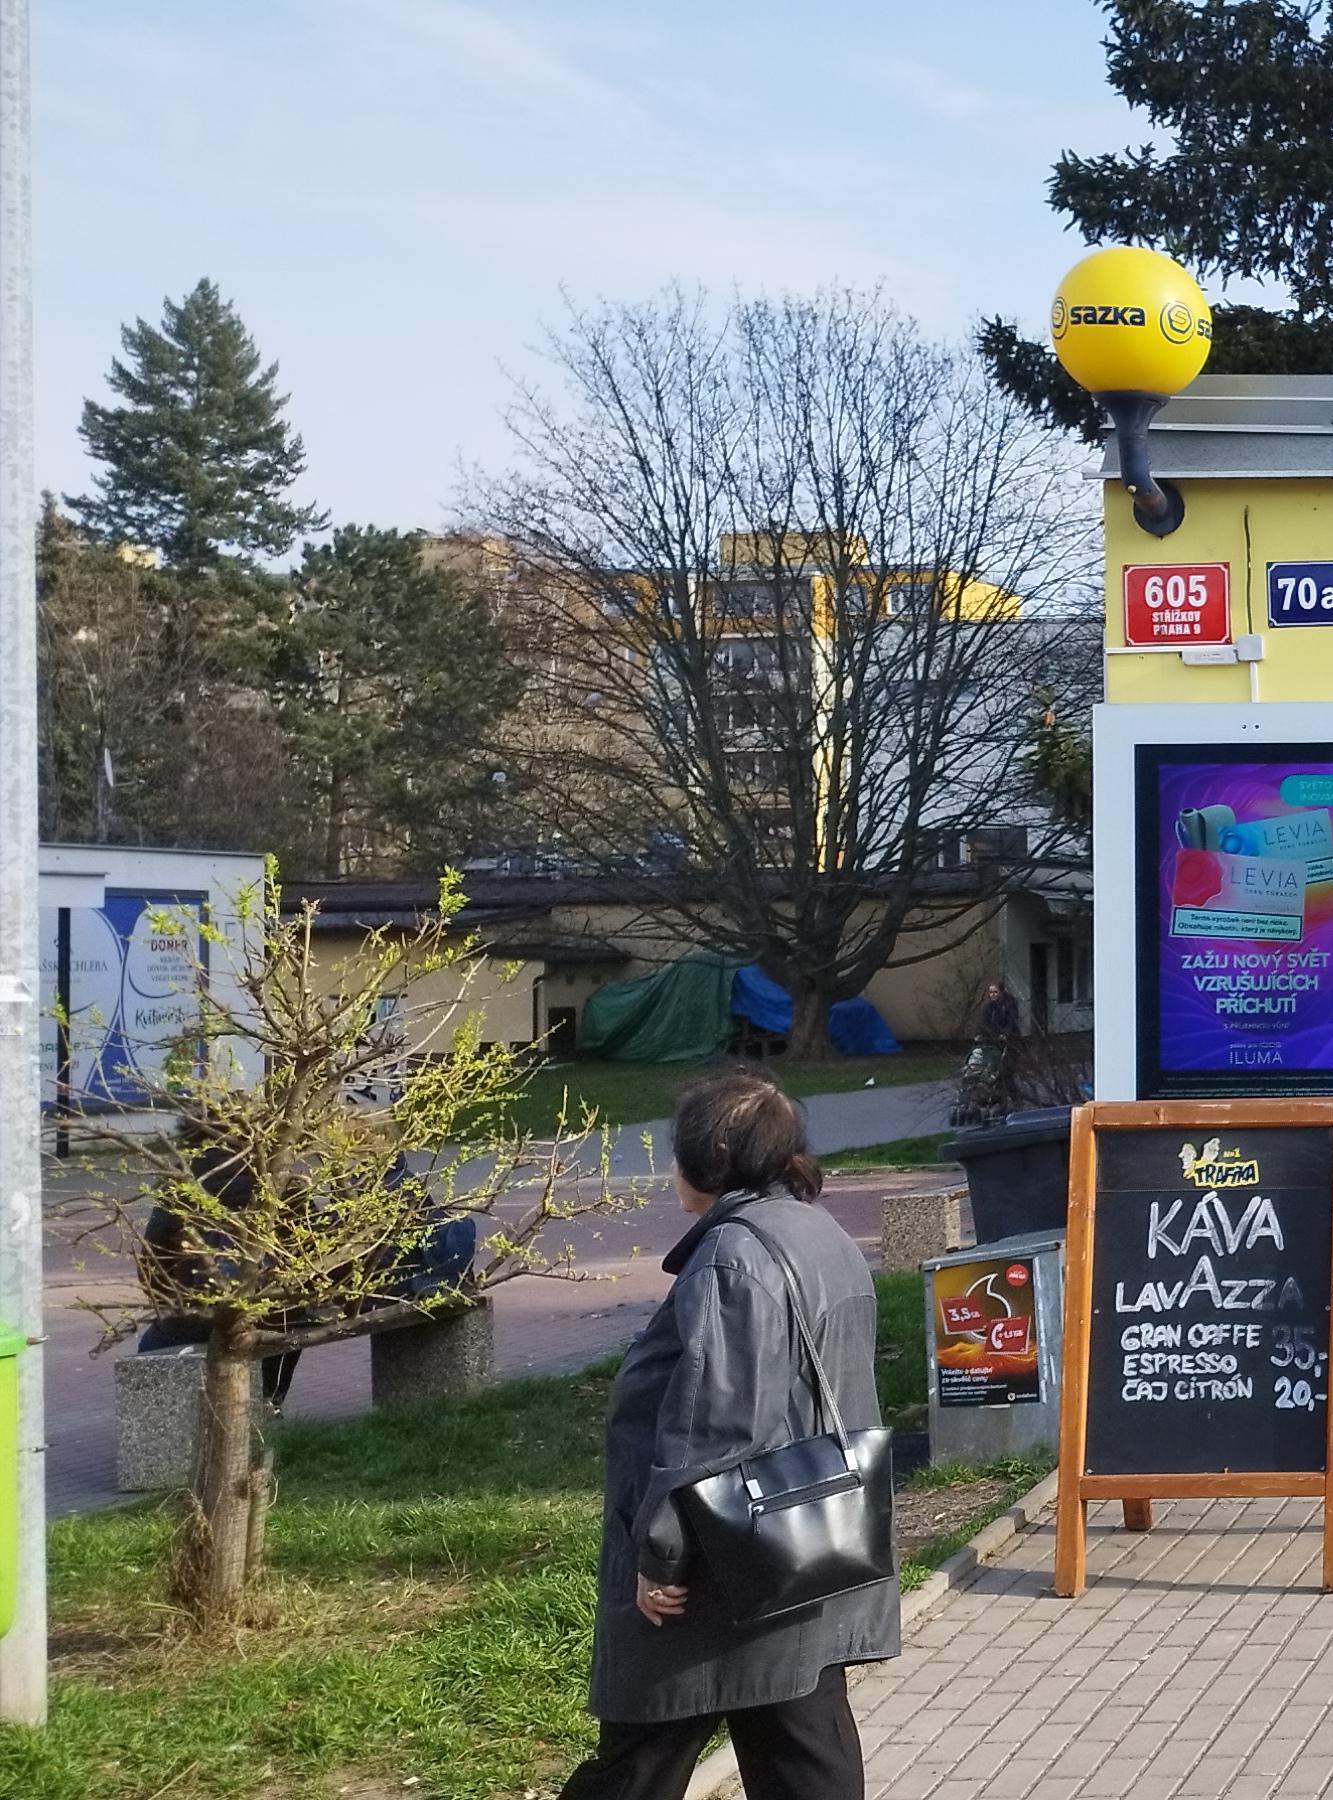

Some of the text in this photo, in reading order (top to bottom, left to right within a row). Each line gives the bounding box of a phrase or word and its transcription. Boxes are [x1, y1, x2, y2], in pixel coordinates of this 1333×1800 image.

[1144, 575, 1208, 608] 605
[1152, 608, 1201, 623] STŘÍŽKOV
[1153, 624, 1201, 636] PRAHA 9
[1263, 820, 1325, 846] LEVIA
[1230, 866, 1298, 889] LEVIA
[1181, 948, 1330, 970] ZAŽIJ NOVÝ SVĚT
[1194, 969, 1319, 992] VZRUŠUJÍCÍCH
[1215, 992, 1298, 1015] PŘÍCHUTÍ
[1229, 1051, 1284, 1066] ILUMA
[1147, 1190, 1285, 1259] KÁVA
[1114, 1254, 1304, 1313] LAVAZZA
[1120, 1322, 1182, 1351] GRAN
[1122, 1351, 1238, 1376] ESPRESSO
[1121, 1377, 1169, 1402] ČAJ
